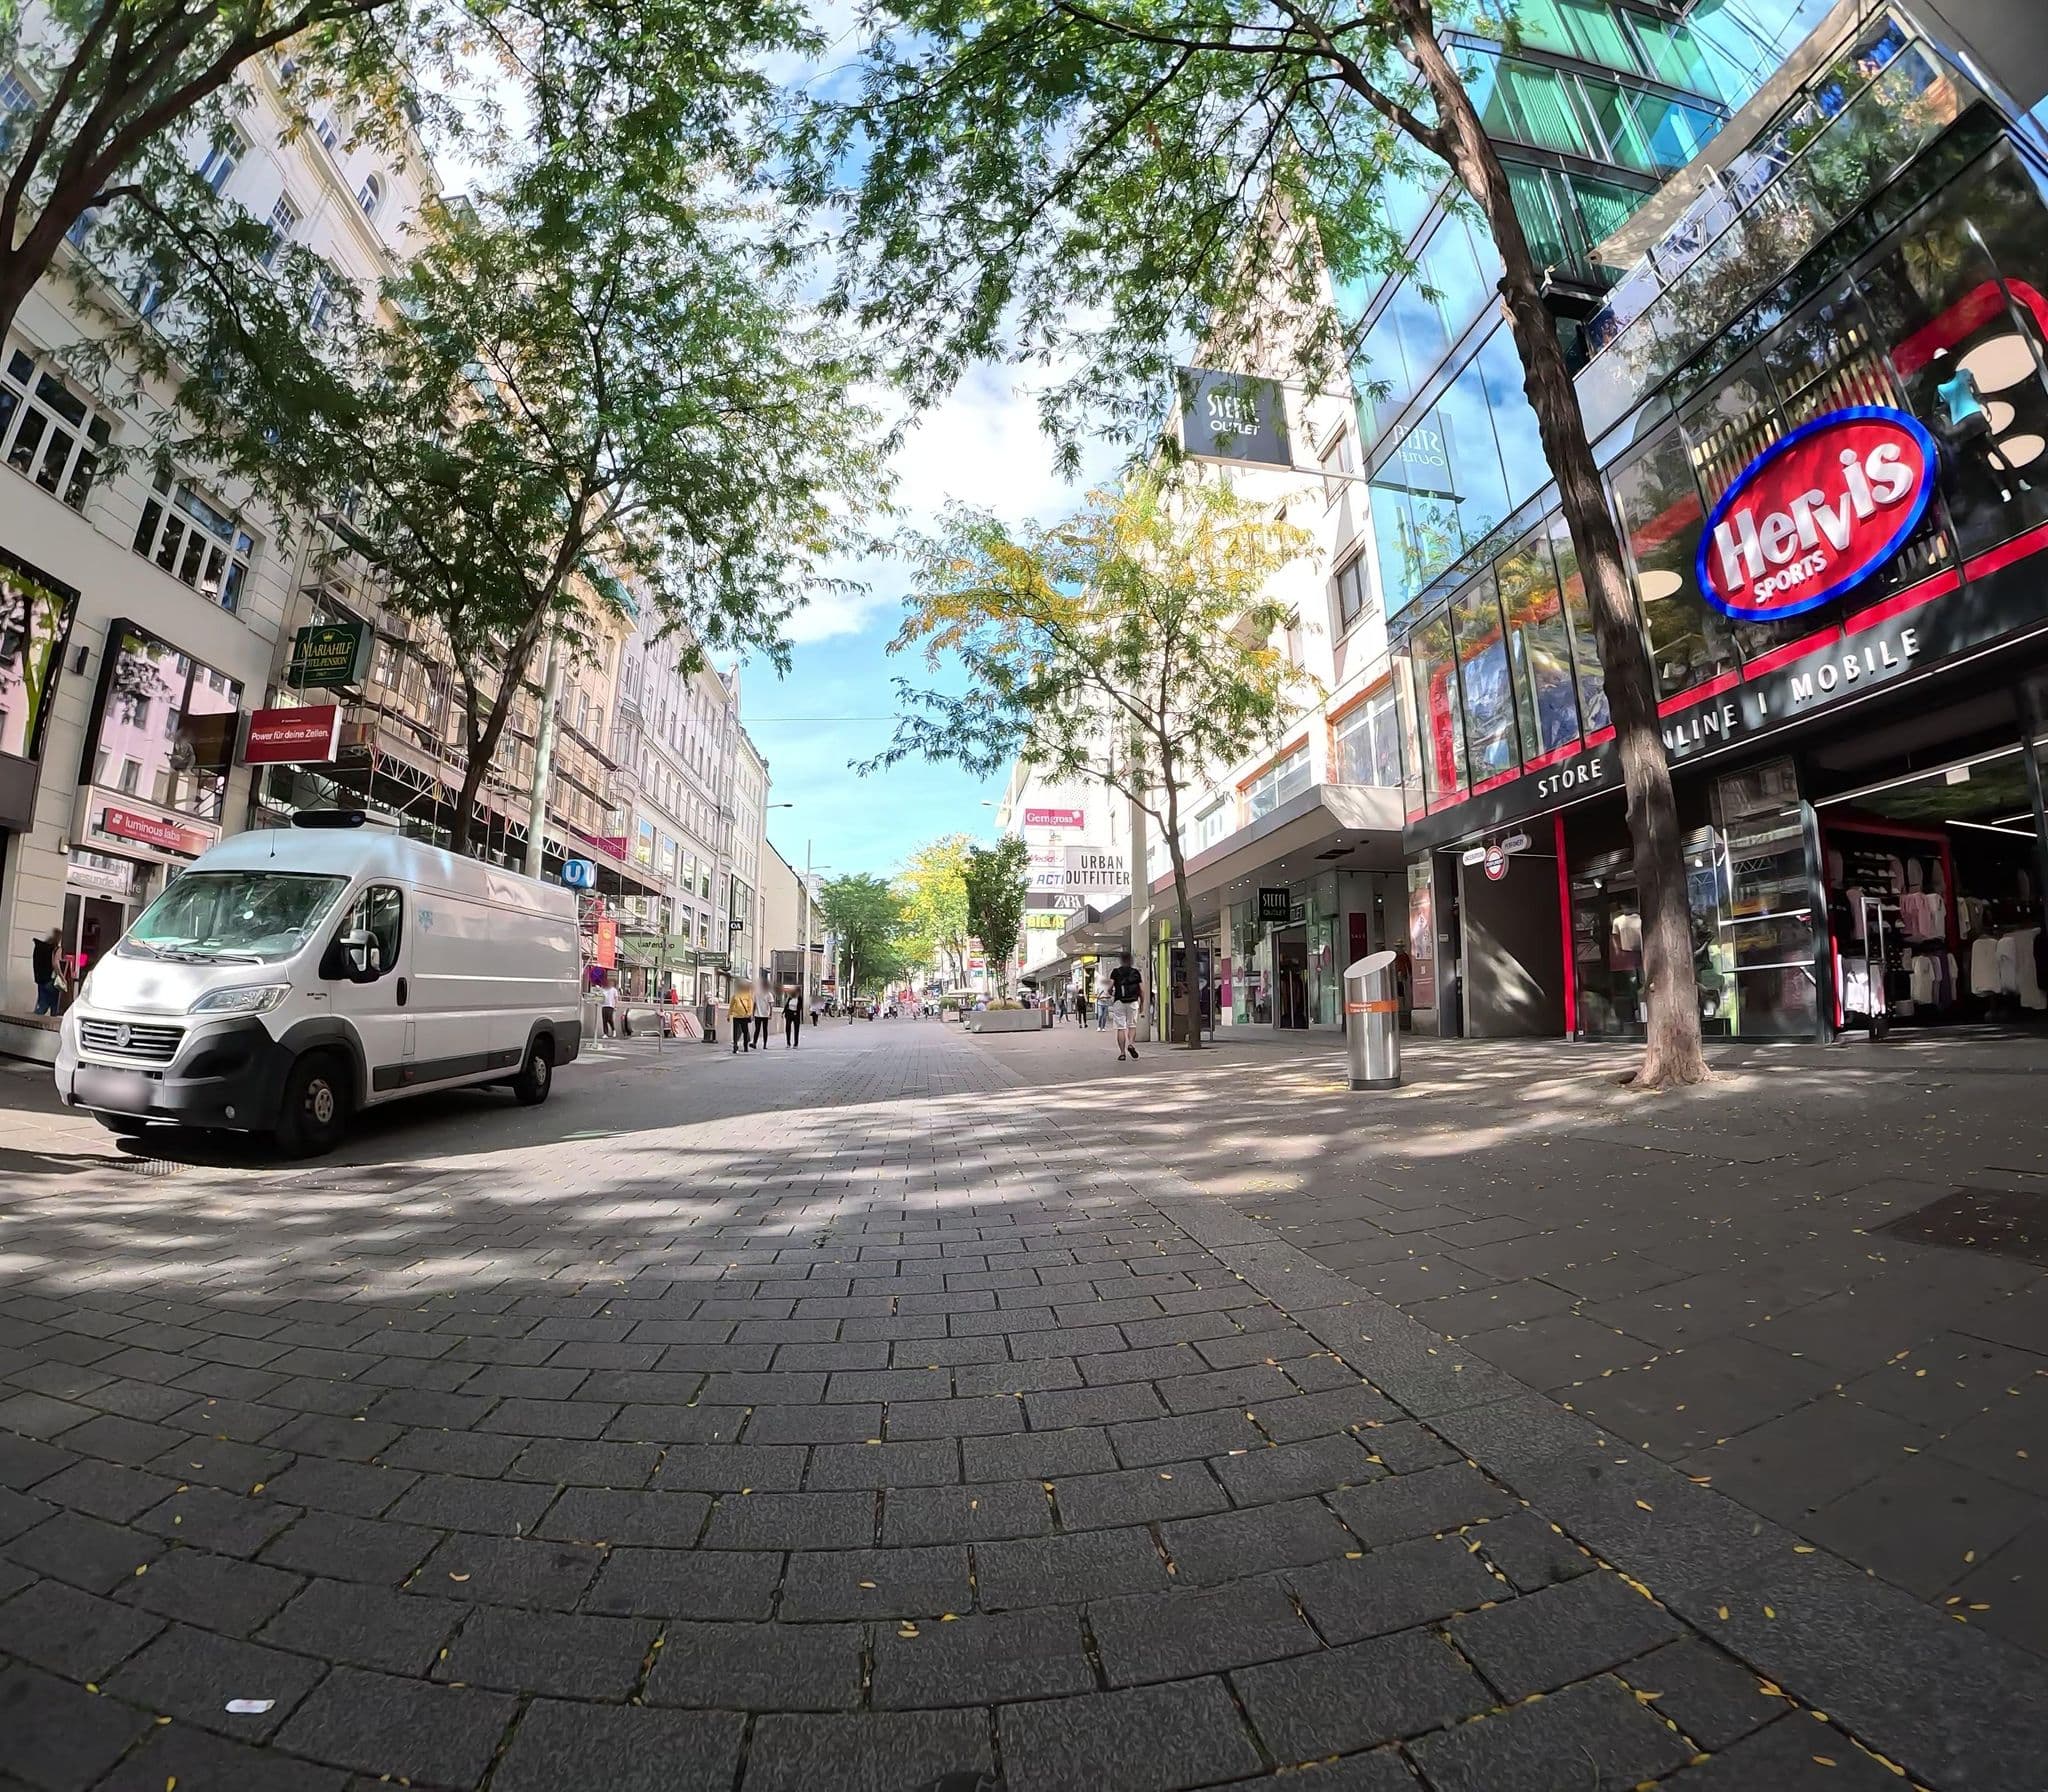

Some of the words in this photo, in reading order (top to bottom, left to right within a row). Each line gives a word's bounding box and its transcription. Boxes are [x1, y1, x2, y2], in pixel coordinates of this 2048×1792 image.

[1210, 420, 1261, 436] OUTLET
[1713, 443, 1914, 592] Hervis
[1753, 550, 1827, 604] SPORTS
[301, 641, 353, 657] MARIAHILF
[1538, 759, 1603, 798] STORE
[1662, 704, 1738, 750] NLINE
[1791, 628, 1921, 702] MOBILE
[251, 731, 273, 740] Power
[273, 730, 283, 740] für
[284, 729, 305, 739] deine
[125, 816, 163, 837] luminous
[1081, 855, 1123, 869] URBAN
[565, 865, 581, 882] U
[1036, 874, 1064, 885] ACTI
[1065, 870, 1130, 885] OUTFITTER
[1053, 895, 1083, 909] ZARA
